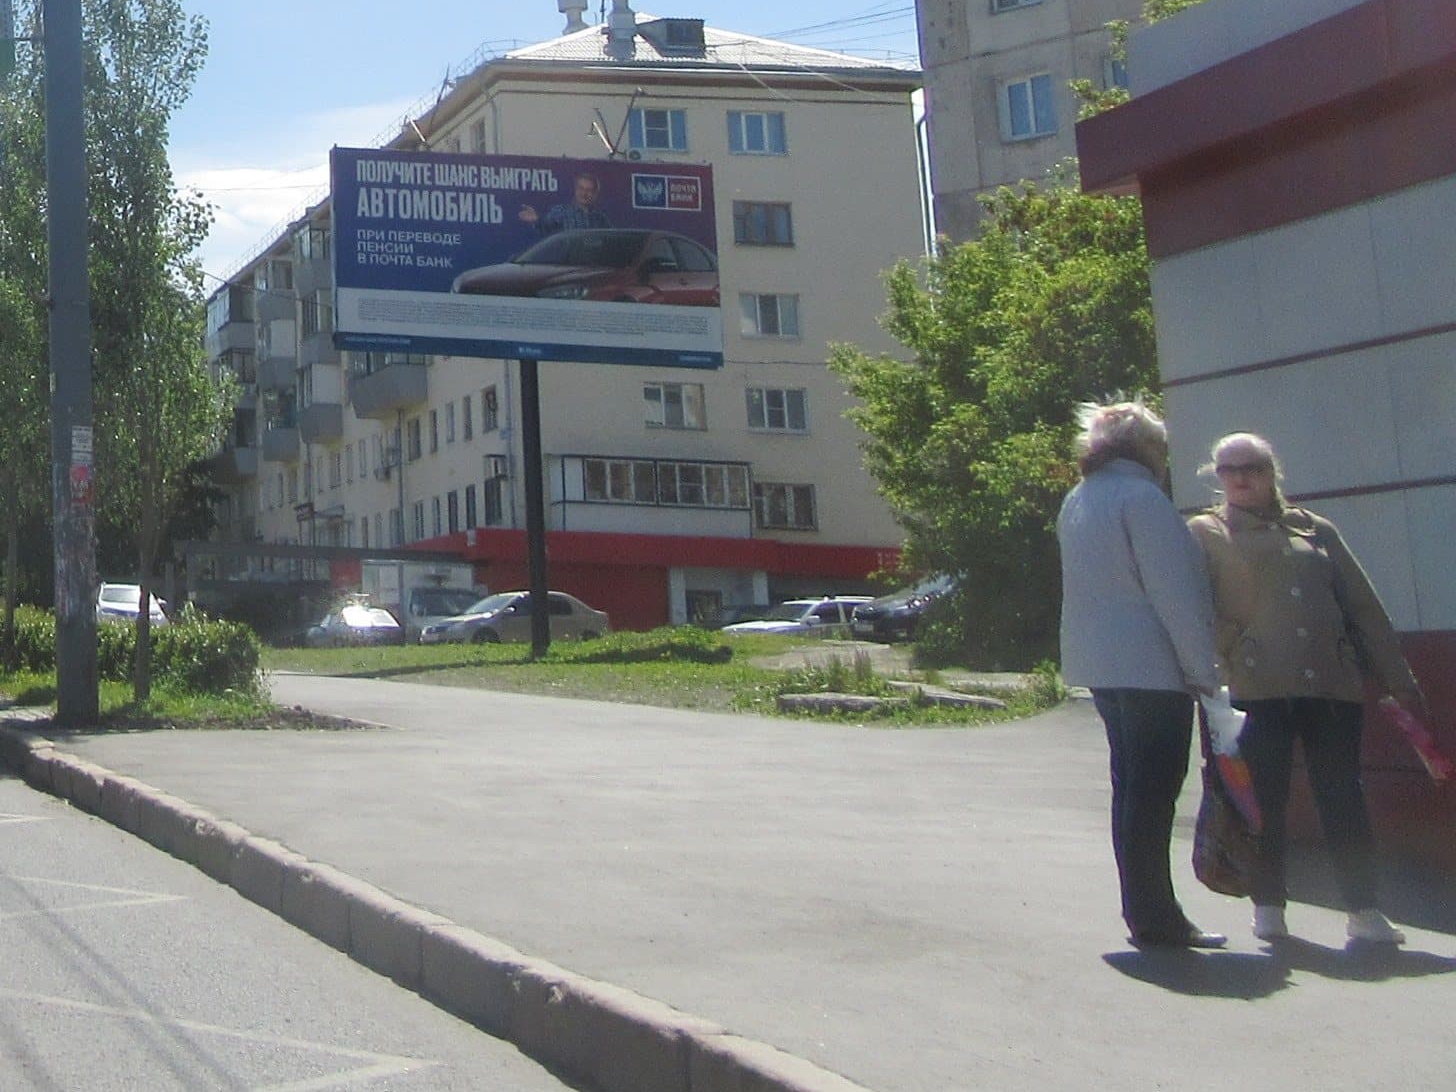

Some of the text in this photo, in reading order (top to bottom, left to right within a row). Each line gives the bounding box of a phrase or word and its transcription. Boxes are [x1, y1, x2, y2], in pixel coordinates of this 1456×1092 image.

[356, 159, 558, 191] ПОЛУЧИТЕ ШАНС ВЫИГРАТЬ
[356, 187, 503, 224] АВТОМОБИЛЬ
[357, 229, 462, 246] ПРИ ПЕРЕВОДЕ
[357, 241, 414, 253] ПЕНСИИ
[357, 253, 454, 268] В ПОЧТА БАНК
